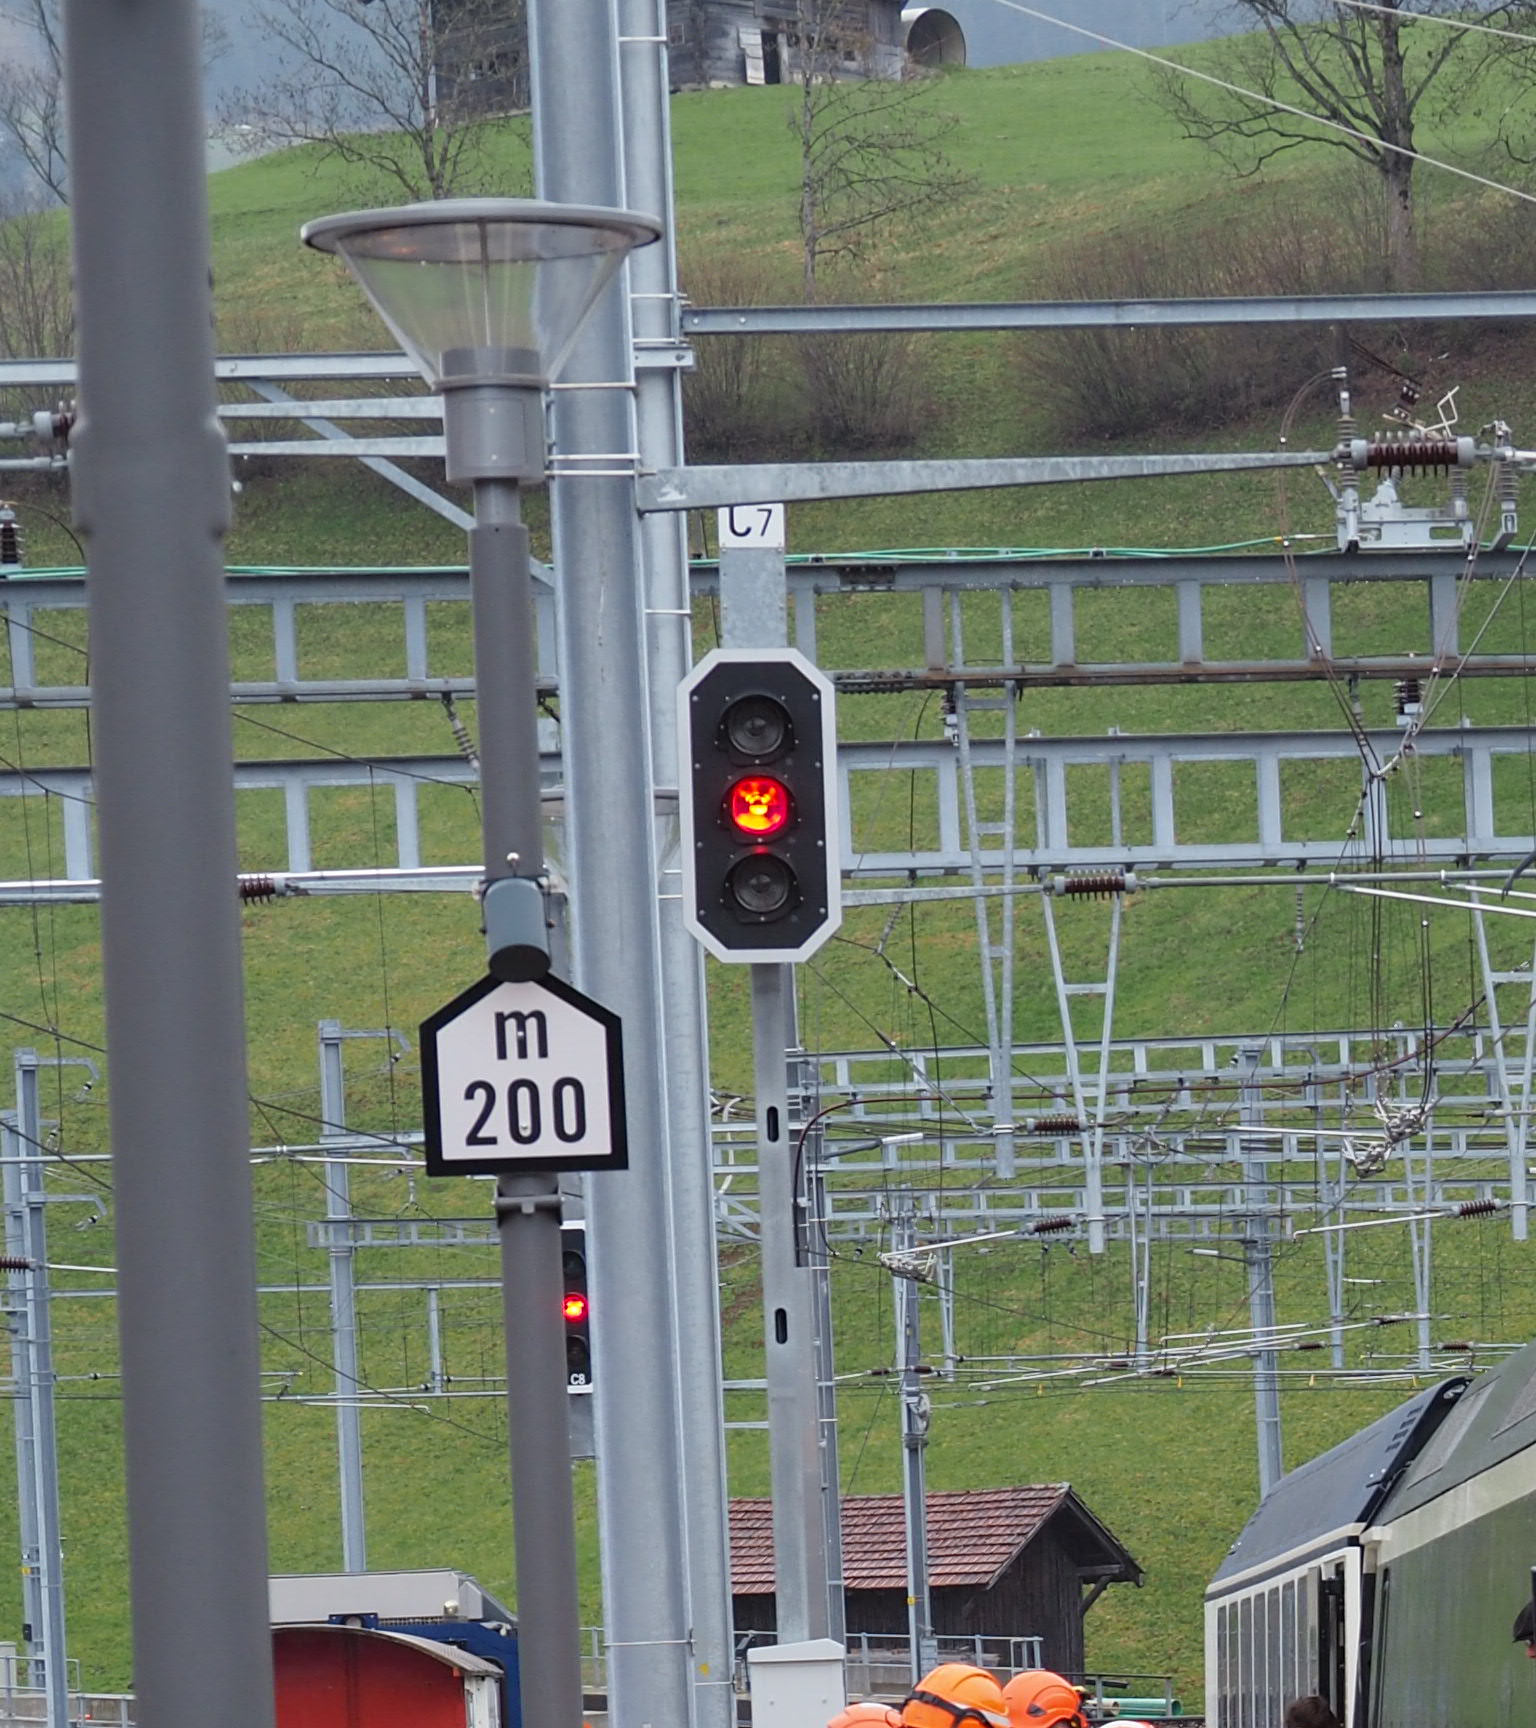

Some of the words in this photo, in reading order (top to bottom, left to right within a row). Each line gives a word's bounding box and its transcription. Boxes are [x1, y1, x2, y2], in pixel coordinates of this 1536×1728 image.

[494, 1009, 549, 1061] m
[463, 1076, 587, 1147] 200
[570, 1373, 586, 1385] C8
